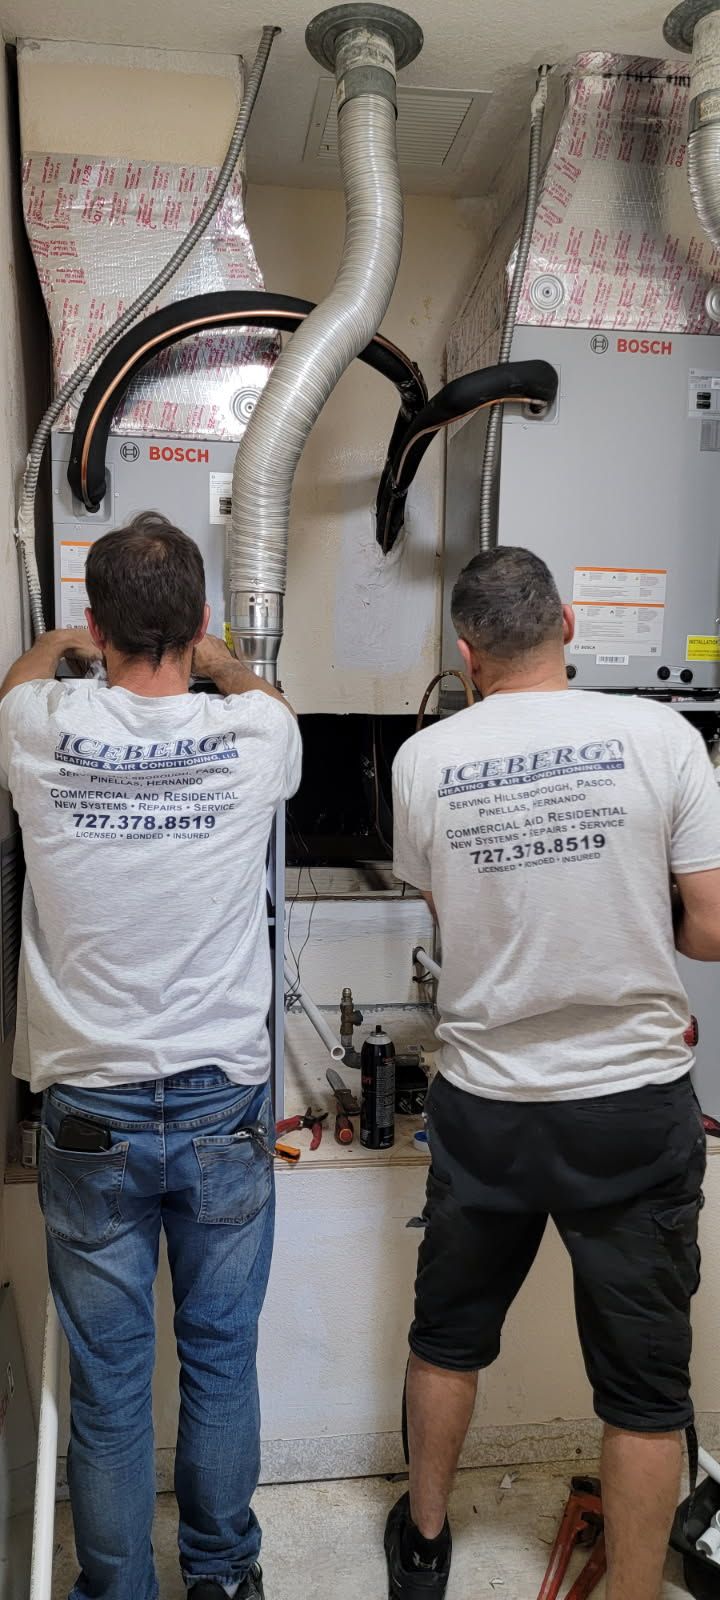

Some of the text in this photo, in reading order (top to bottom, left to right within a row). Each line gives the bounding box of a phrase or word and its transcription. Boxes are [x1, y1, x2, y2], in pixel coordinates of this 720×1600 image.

[617, 338, 672, 355] BOSCH
[149, 446, 209, 463] BOSCH
[55, 731, 222, 762] ICEBERG
[56, 753, 98, 767] HEATING
[102, 762, 111, 770] &
[439, 740, 606, 788] ICEBERG
[146, 777, 203, 786] HERNANDO
[439, 782, 485, 797] HEATING
[487, 780, 495, 788] &
[499, 777, 520, 786] AIR
[605, 762, 622, 770] LLC
[50, 788, 238, 802] COMMERCIAL AND RESIDENTIAL
[449, 797, 491, 810] SERVING
[577, 778, 616, 788] PASCO,
[55, 800, 235, 811] NEW SYSTEMS REPAIRS SERVICE
[479, 804, 530, 817] PINELLAS,
[72, 813, 216, 830] 727.378.8519
[446, 821, 520, 840] COMMERCIAL
[547, 806, 628, 822] RESIDENTIAL
[75, 831, 116, 839] LICENSED
[450, 840, 472, 850] NEW
[475, 833, 519, 846] SYSTEMS
[579, 818, 625, 830] SERVICE
[469, 833, 606, 865] 727.378.8519
[478, 864, 516, 874] LICENSED
[562, 852, 601, 863] INSURED
